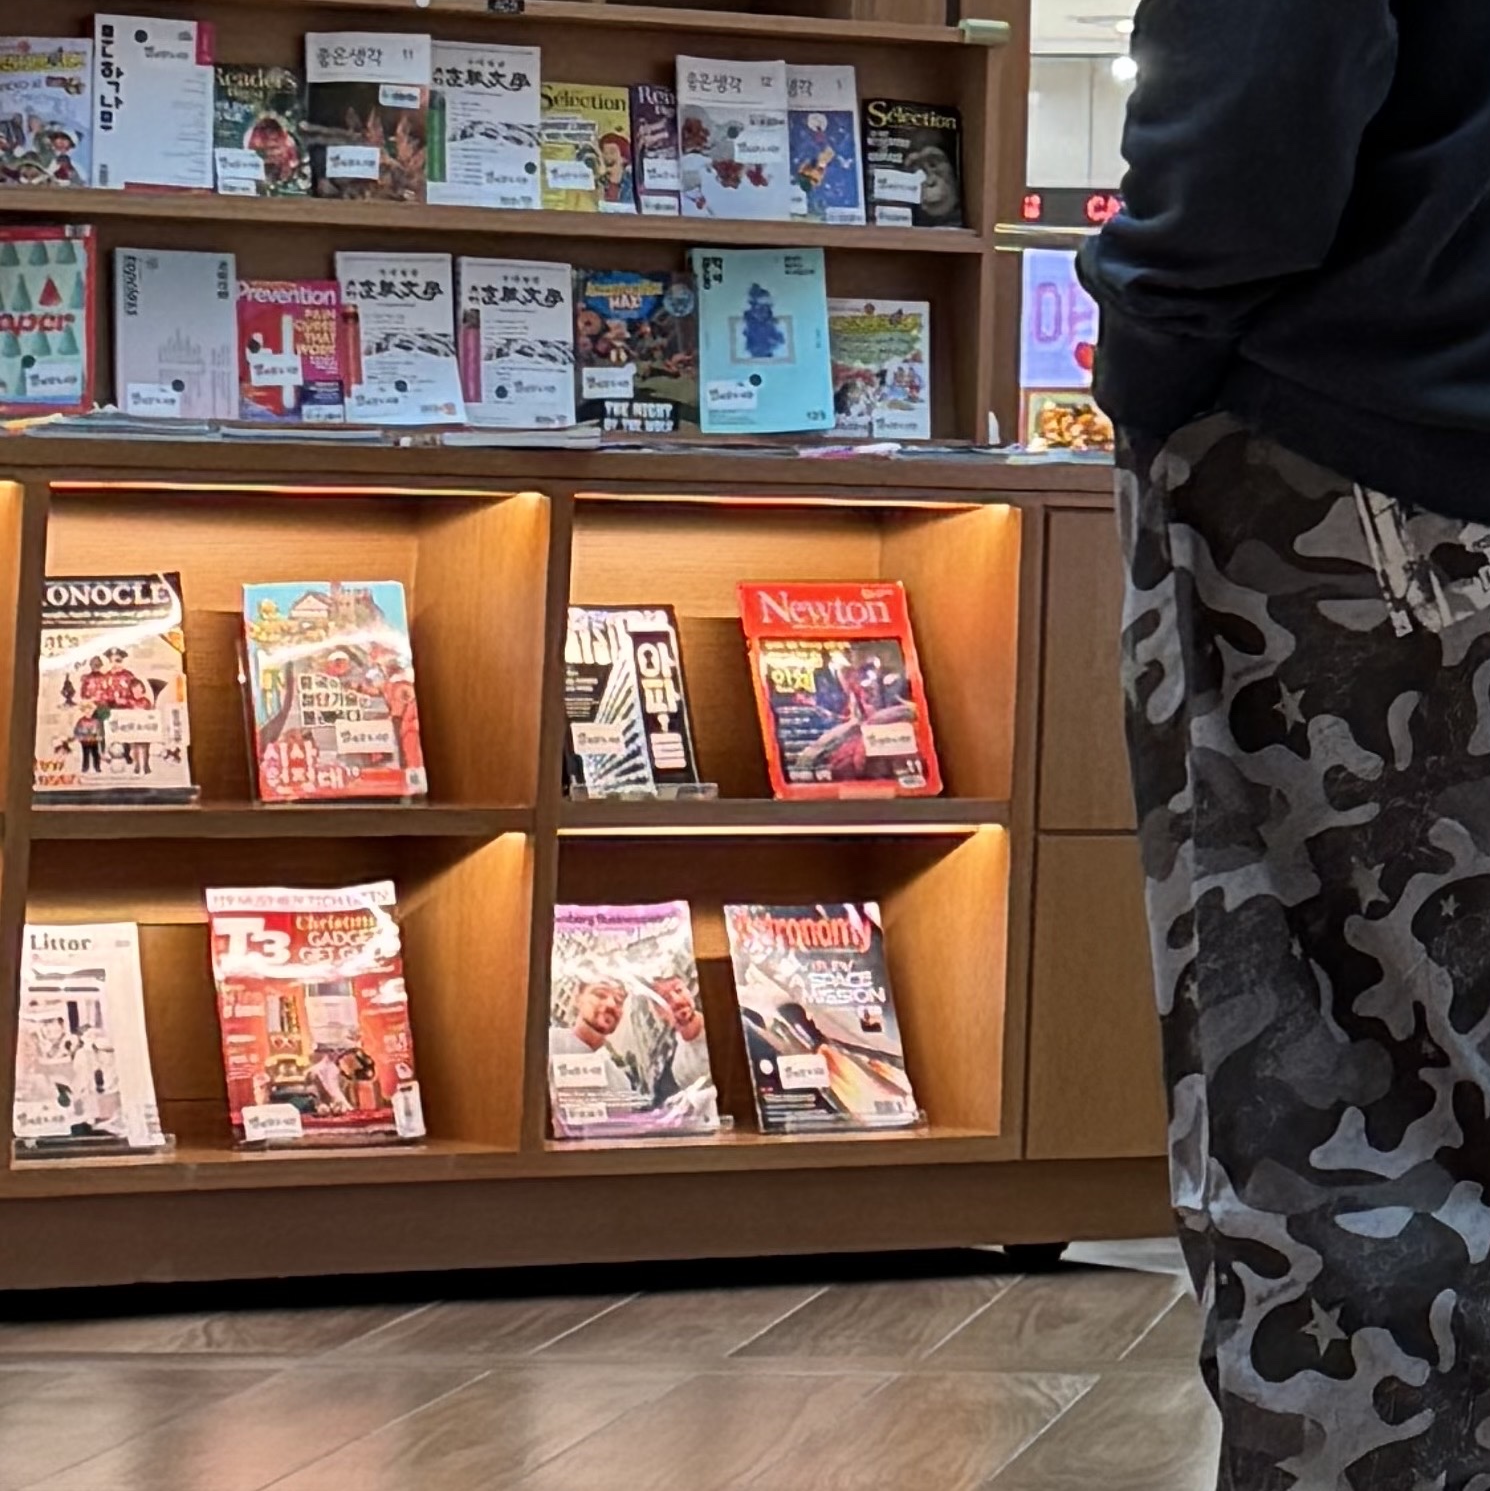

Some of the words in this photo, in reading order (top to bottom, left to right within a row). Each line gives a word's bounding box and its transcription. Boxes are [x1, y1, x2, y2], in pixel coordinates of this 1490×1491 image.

[318, 47, 383, 69] 좋은생각
[758, 590, 893, 625] Newton
[213, 917, 290, 966] T3
